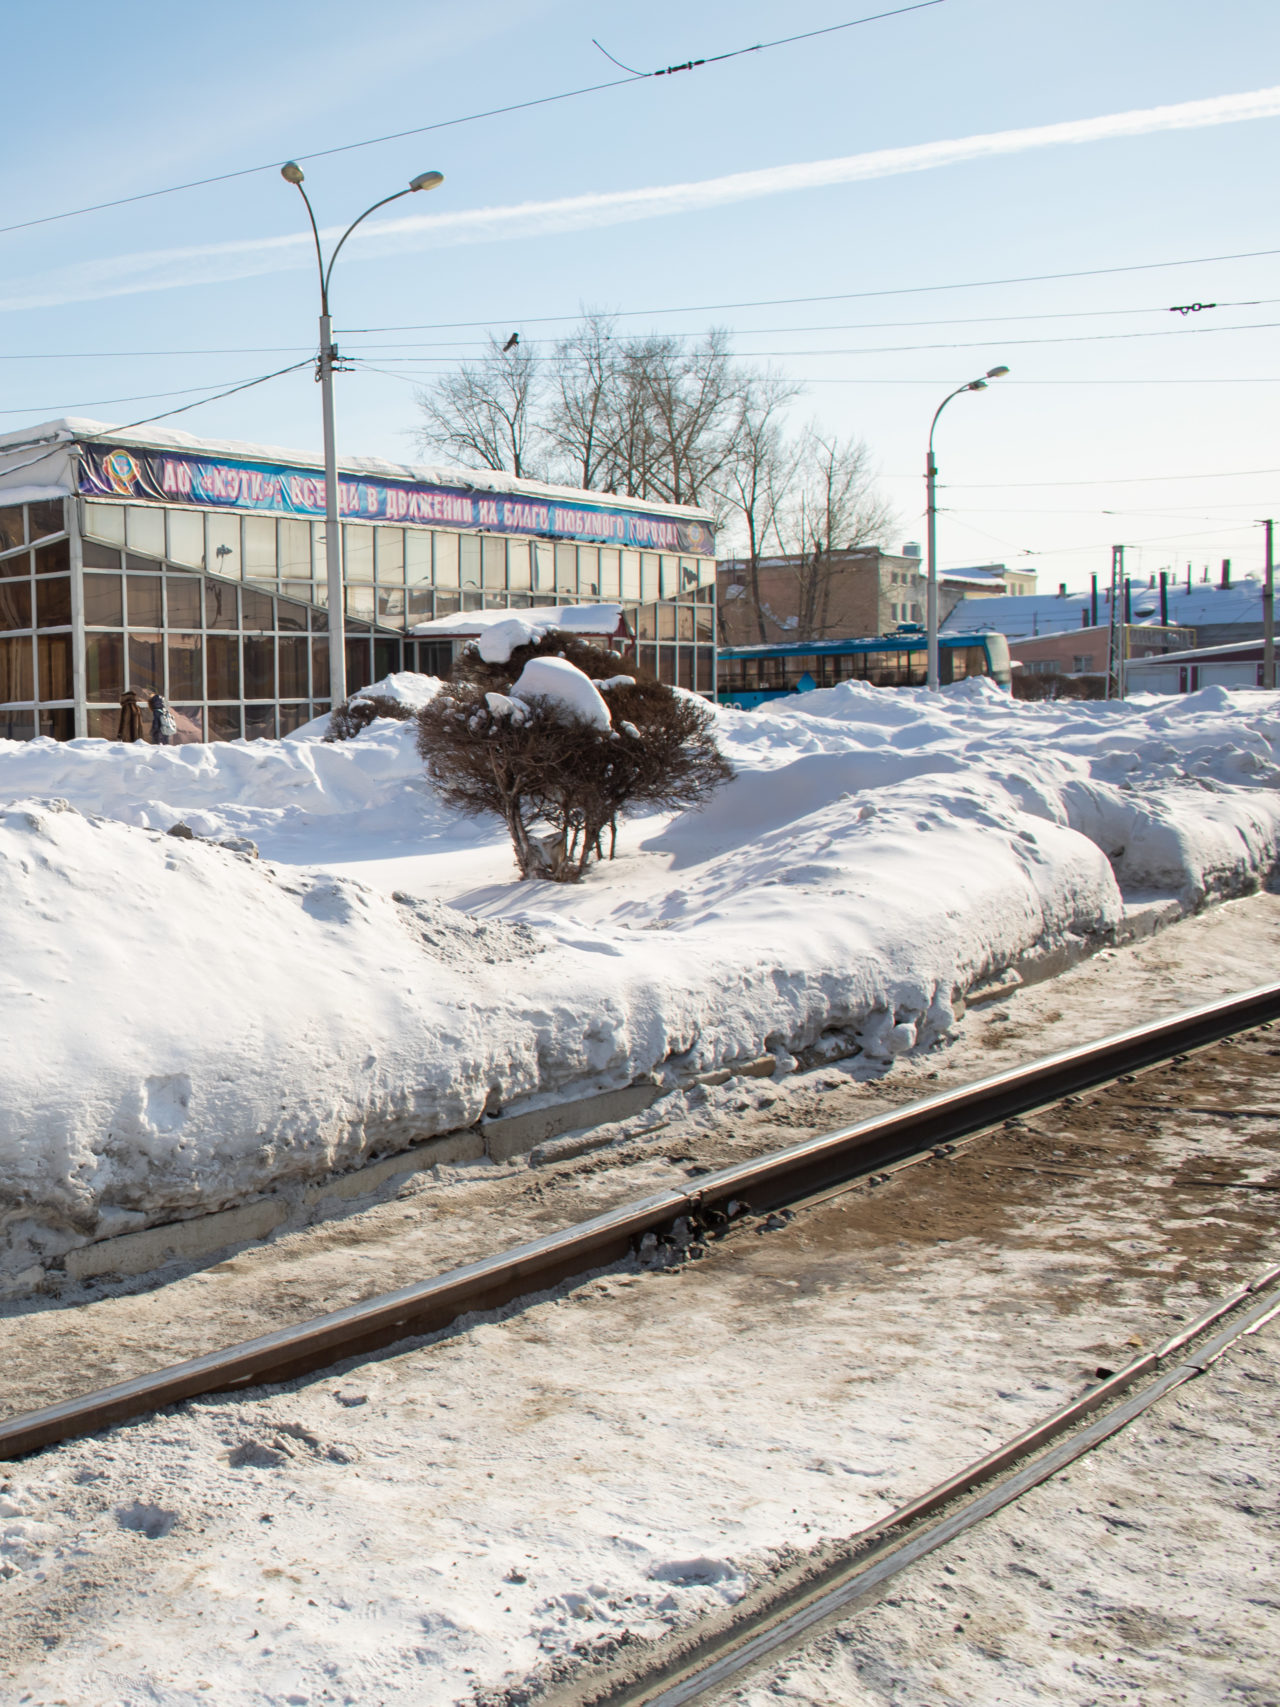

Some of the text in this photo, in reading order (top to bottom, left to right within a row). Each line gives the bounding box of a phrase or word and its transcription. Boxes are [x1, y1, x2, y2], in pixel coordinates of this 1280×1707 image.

[163, 461, 191, 494] АО
[290, 475, 360, 515] ВСЕДА
[366, 486, 378, 513] В
[386, 488, 473, 522] ДВИЖЕНИИ
[478, 500, 498, 525] НА
[503, 502, 548, 529] БЛАГО
[554, 508, 625, 539] ЛЮБИМОГО
